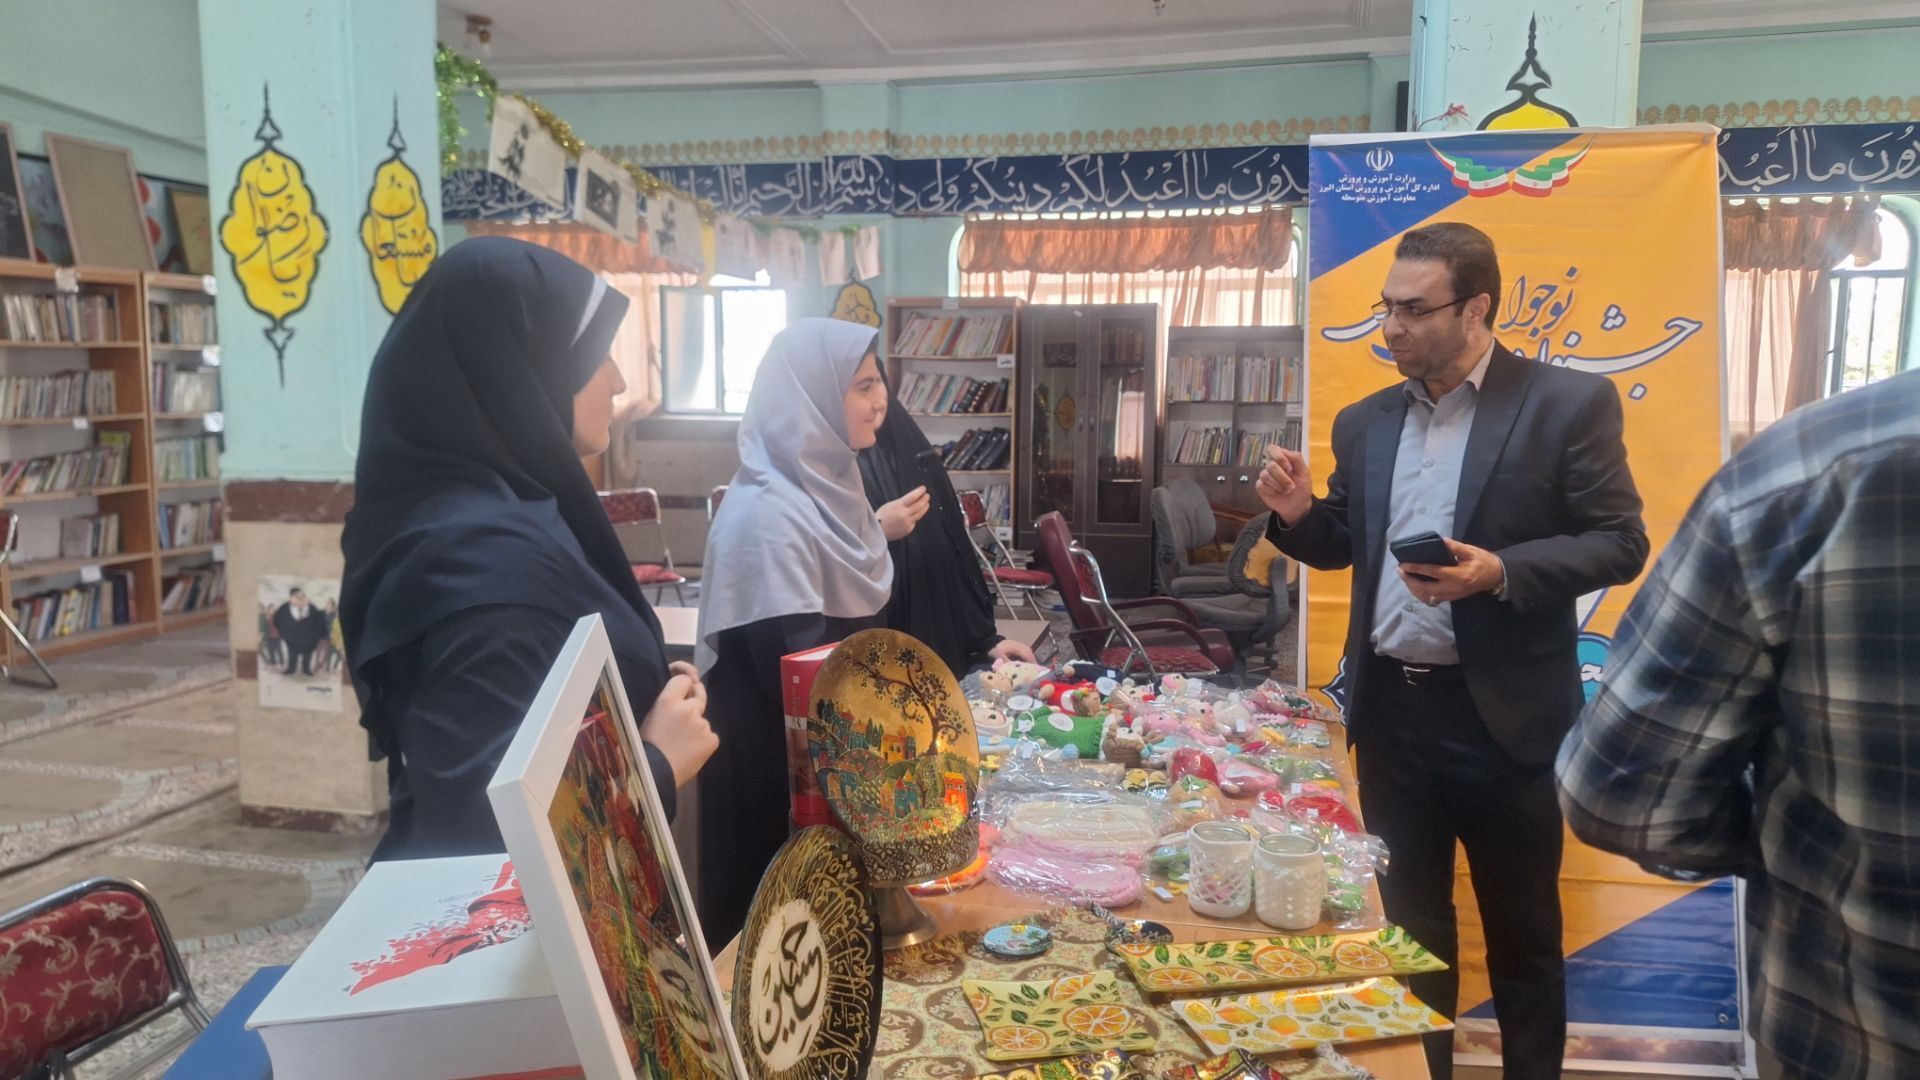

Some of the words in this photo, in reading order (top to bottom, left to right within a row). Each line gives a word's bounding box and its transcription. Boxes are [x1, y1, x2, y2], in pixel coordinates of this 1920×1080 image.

[1338, 174, 1362, 184] پرورش
[1368, 173, 1393, 184] آموزش
[1395, 173, 1416, 184] وزارت
[1354, 184, 1378, 194] پرورش
[1384, 183, 1409, 194] آموزش
[1366, 194, 1392, 205] آموزش
[1392, 194, 1417, 204] معاونت
[1498, 266, 1577, 338] نوجوا
